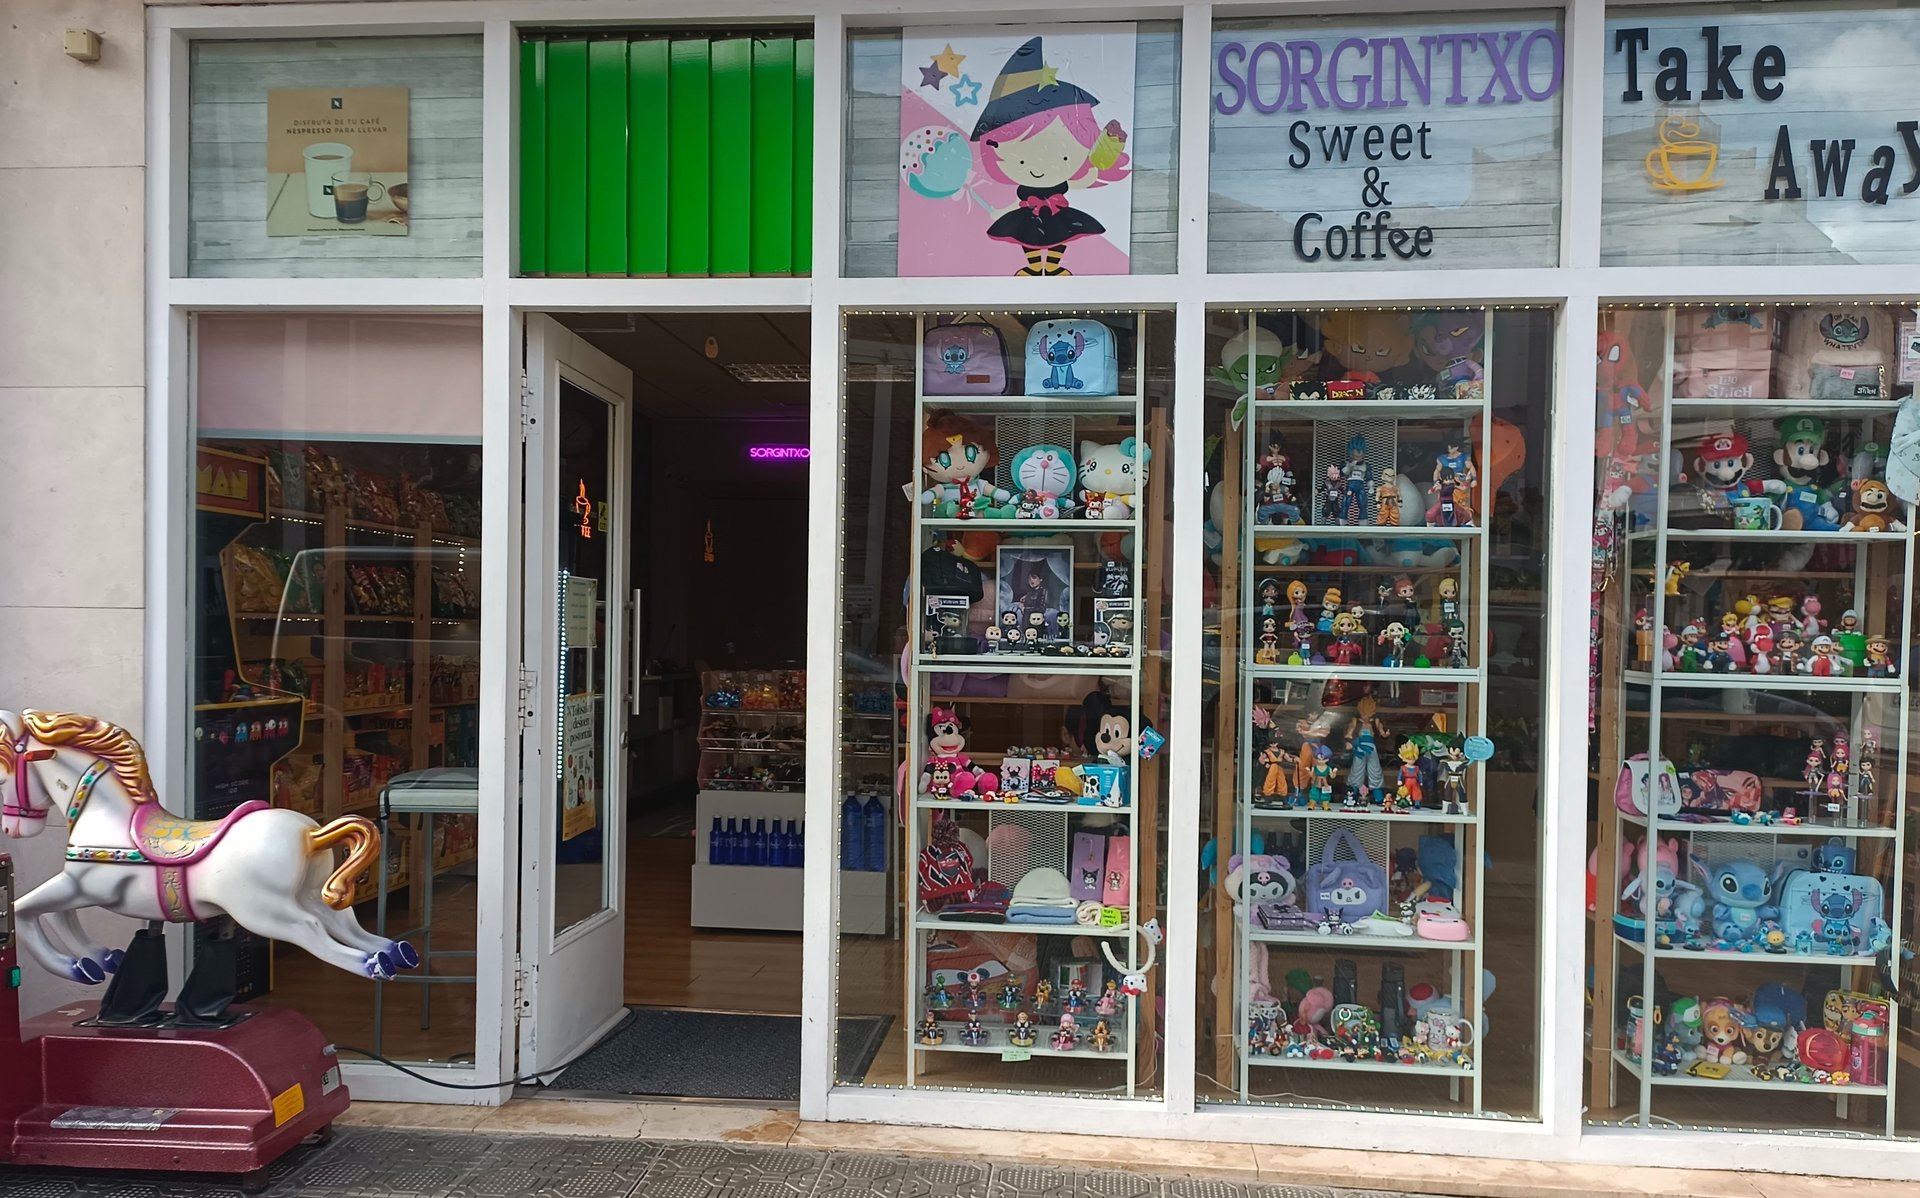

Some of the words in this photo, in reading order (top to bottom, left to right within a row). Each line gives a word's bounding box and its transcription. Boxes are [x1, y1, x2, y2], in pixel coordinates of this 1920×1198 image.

[1215, 28, 1565, 115] SORGINTXO
[1616, 25, 1787, 101] Take
[286, 127, 332, 135] NESPRESSO
[334, 126, 355, 134] PARA
[293, 119, 331, 127] DISFRUTA
[360, 117, 380, 125] CAFÉ
[1288, 120, 1432, 169] Sweet
[1361, 166, 1393, 209] &
[1293, 211, 1434, 262] Coffee
[1801, 420, 1814, 432] L
[750, 447, 811, 458] SORGINTXO
